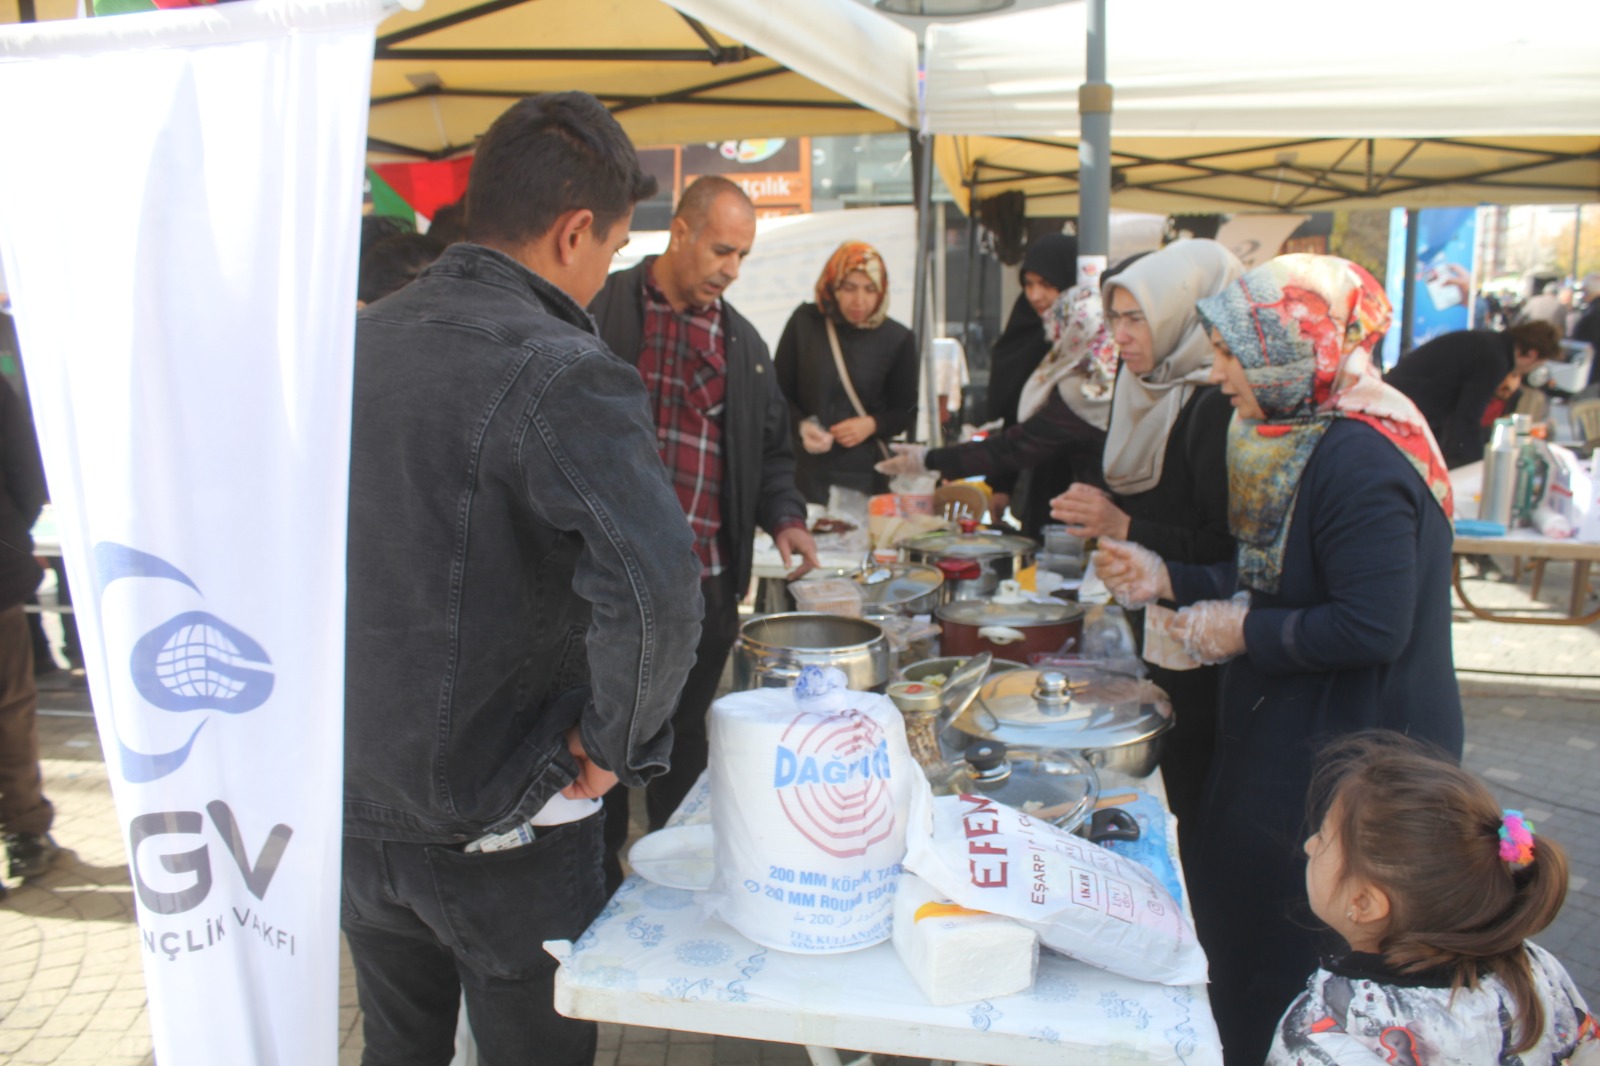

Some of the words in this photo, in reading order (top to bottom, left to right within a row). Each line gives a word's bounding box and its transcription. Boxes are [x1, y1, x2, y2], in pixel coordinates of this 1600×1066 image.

[737, 176, 791, 201] tçılık
[769, 865, 795, 884] 200
[800, 871, 827, 888] MM
[831, 869, 872, 893] KÖPK
[1031, 854, 1049, 905] EŞARP
[788, 891, 816, 908] MM
[142, 914, 226, 962] NÇLİK
[232, 906, 295, 957] VAKFI
